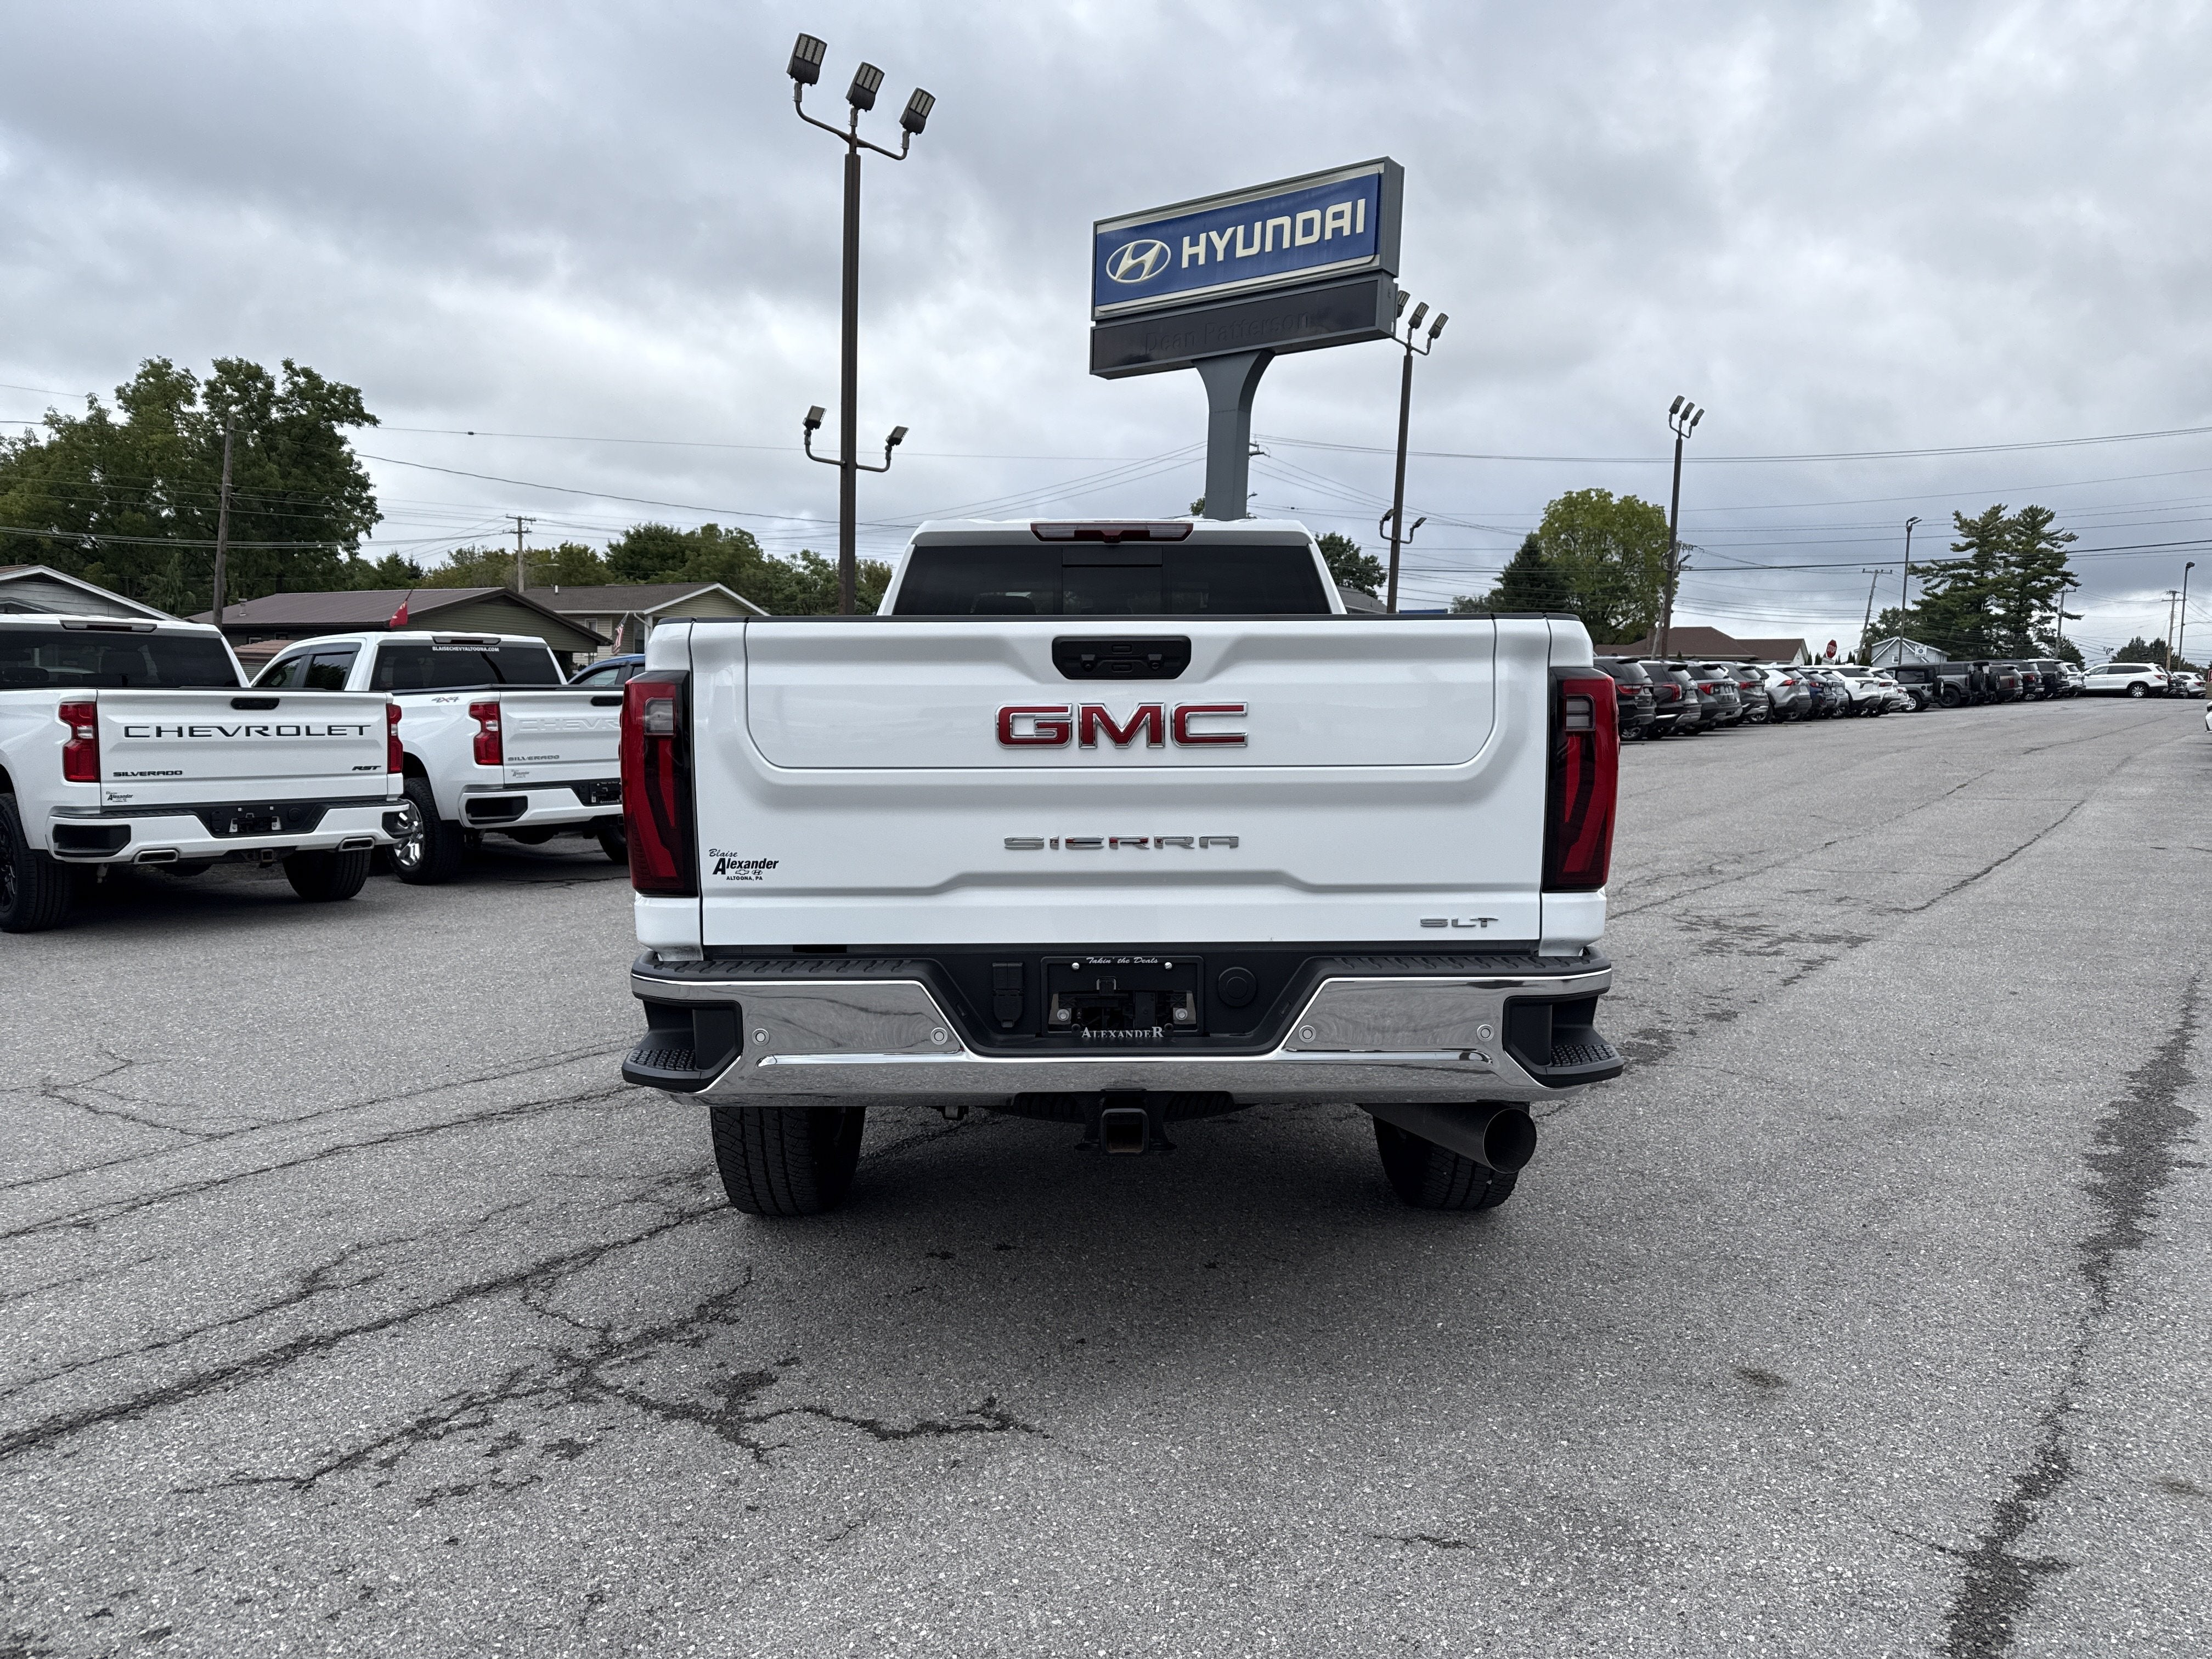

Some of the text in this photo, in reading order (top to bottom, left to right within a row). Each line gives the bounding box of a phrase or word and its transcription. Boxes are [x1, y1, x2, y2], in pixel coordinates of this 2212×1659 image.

[1182, 199, 1366, 268] HYUNDAI
[1145, 312, 1310, 354] Dean Patterson
[1827, 645, 1836, 653] STOP
[124, 725, 371, 738] CHEVROLET
[996, 702, 1248, 748] GMC
[1004, 834, 1239, 850] SIERRA
[708, 848, 738, 857] Blaise
[712, 857, 779, 875] Alexander
[1420, 917, 1499, 927] SLT
